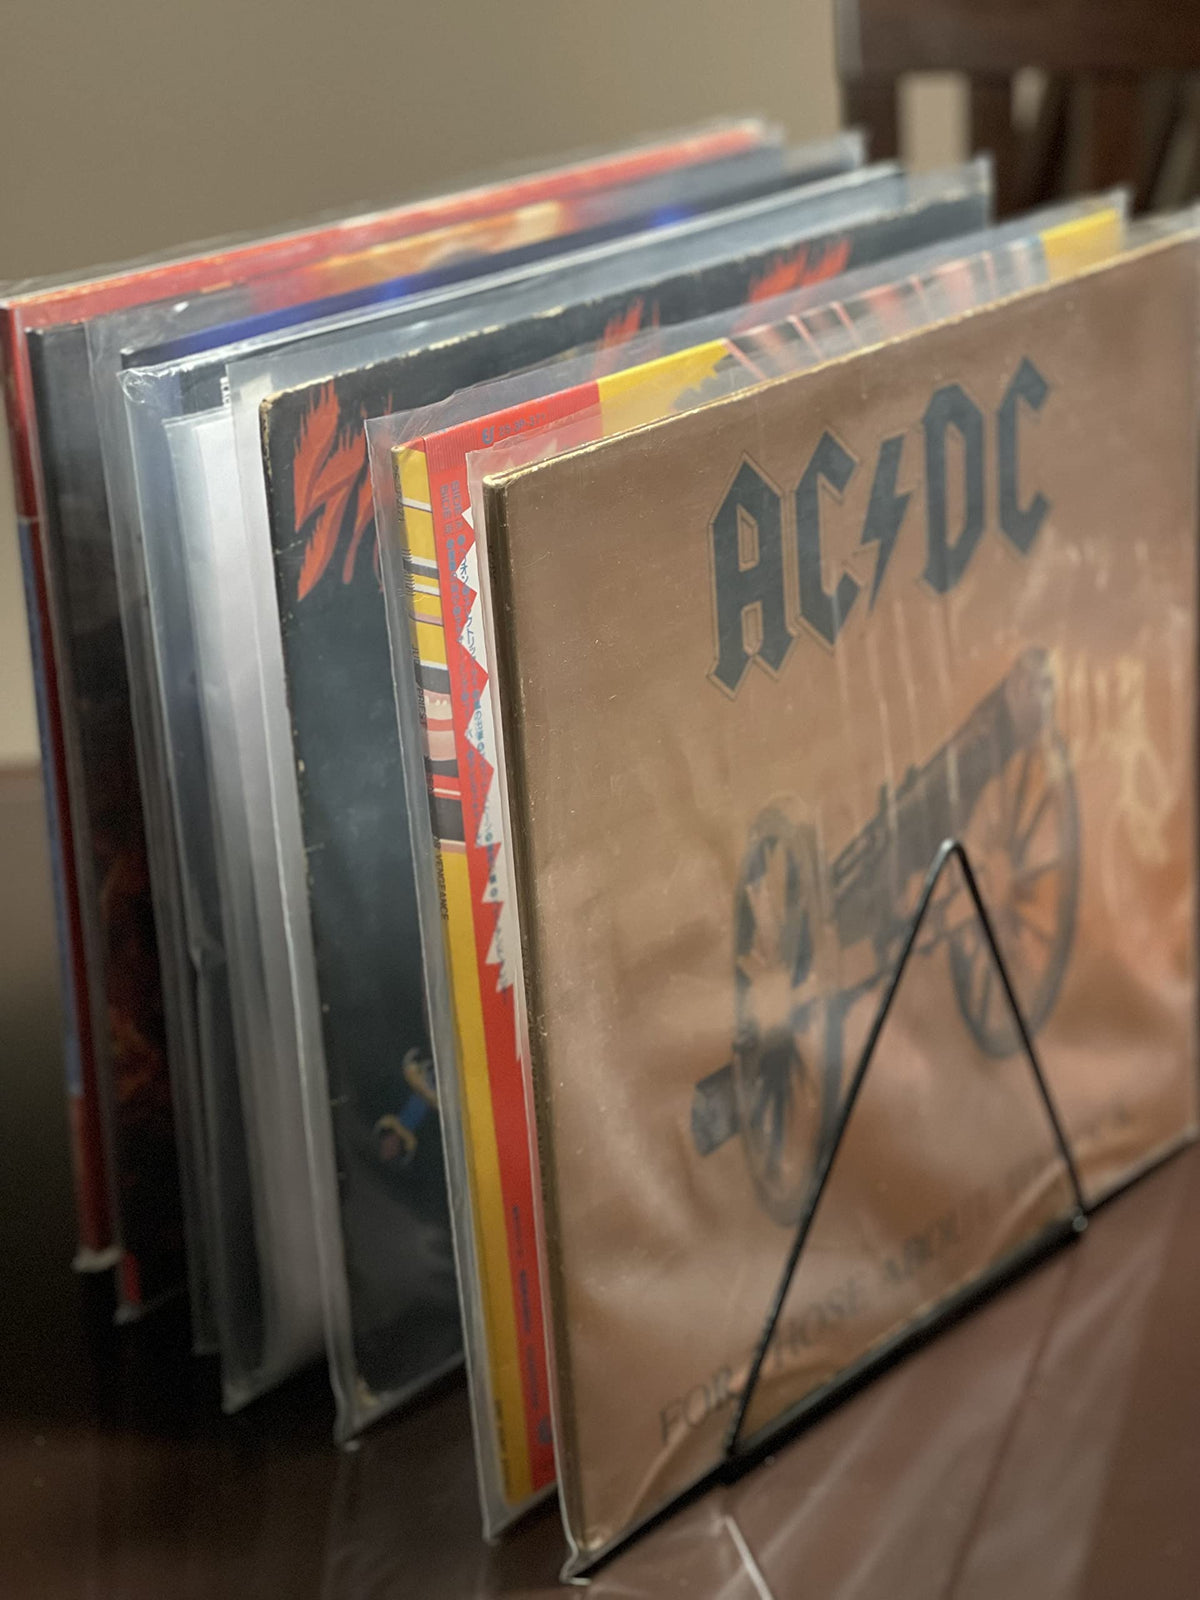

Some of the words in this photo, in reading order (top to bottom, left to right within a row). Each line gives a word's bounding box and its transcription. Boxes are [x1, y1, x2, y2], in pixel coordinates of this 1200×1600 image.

[440, 484, 452, 519] SIDE
[451, 480, 463, 515] SIDE
[417, 687, 427, 728] PRIEST
[436, 851, 449, 920] VENGEANCE
[659, 1366, 734, 1442] FOR
